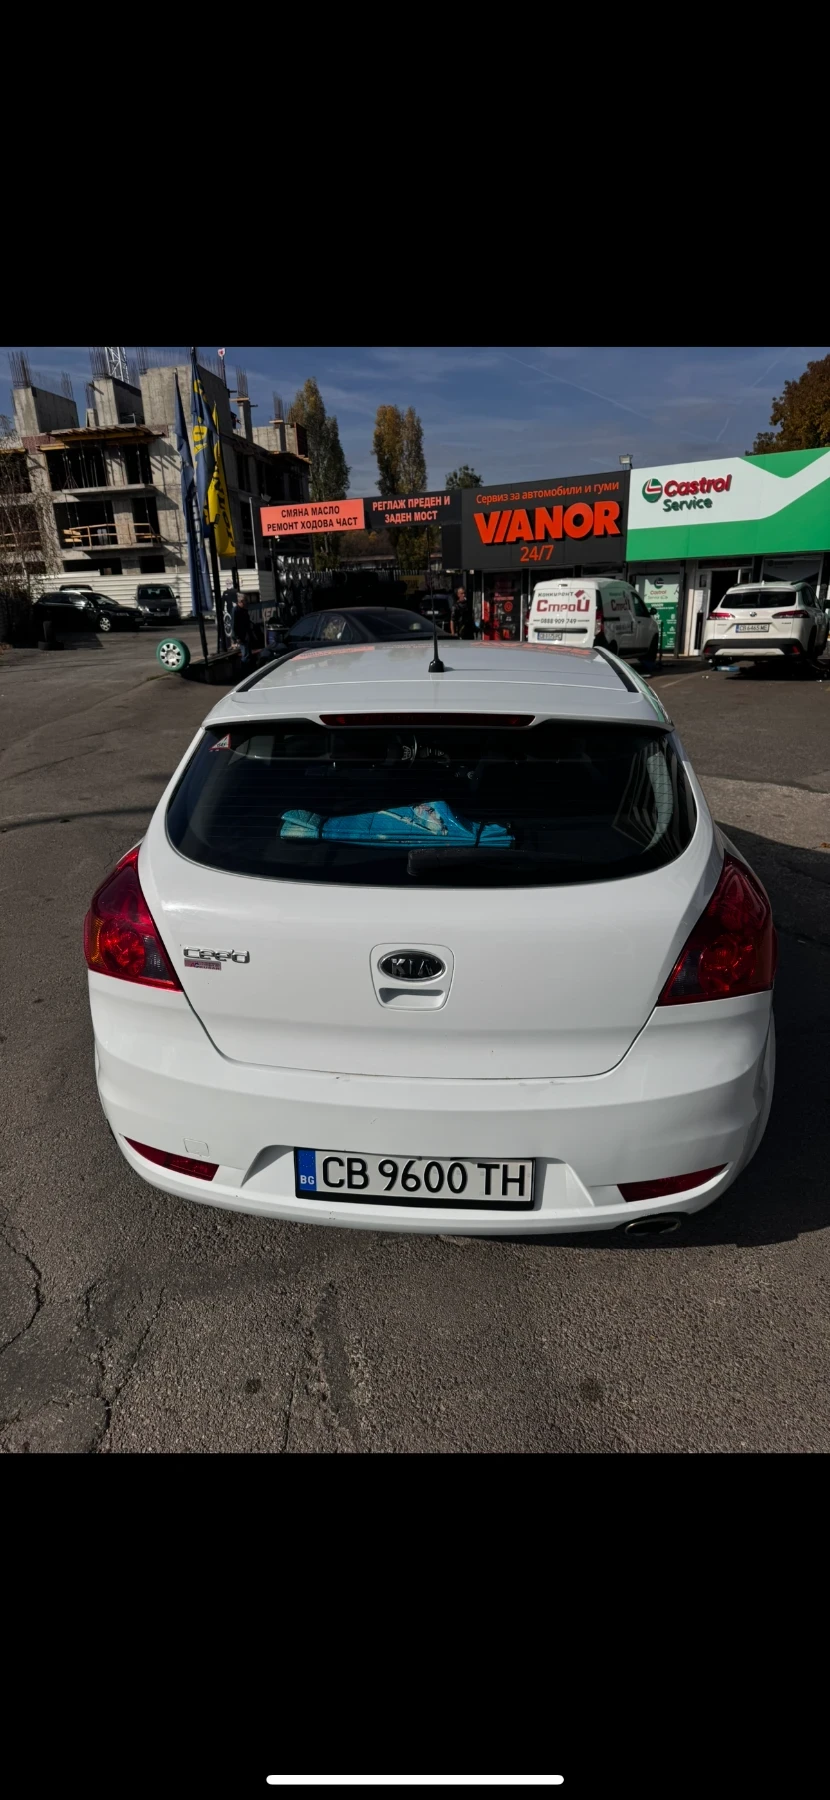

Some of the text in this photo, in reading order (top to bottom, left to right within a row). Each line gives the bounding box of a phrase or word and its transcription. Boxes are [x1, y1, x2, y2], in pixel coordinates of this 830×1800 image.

[476, 481, 619, 505] Сервиз за автомобили и гуми
[664, 474, 732, 497] Castrol
[281, 505, 340, 518] СМЯНА МАСЛО
[372, 495, 451, 512] РЕГЛАЖ ПРЕДЕН И
[663, 496, 713, 512] Service
[267, 516, 358, 532] РЕМОНТ ХОДОВА ЧАСТ
[385, 510, 438, 524] ЗАДЕН МОСТ
[473, 500, 621, 544] VIANOR
[520, 544, 554, 562] 24/7
[391, 957, 433, 978] KIA
[300, 1174, 315, 1186] BG
[322, 1156, 525, 1197] CB 9600 TH
